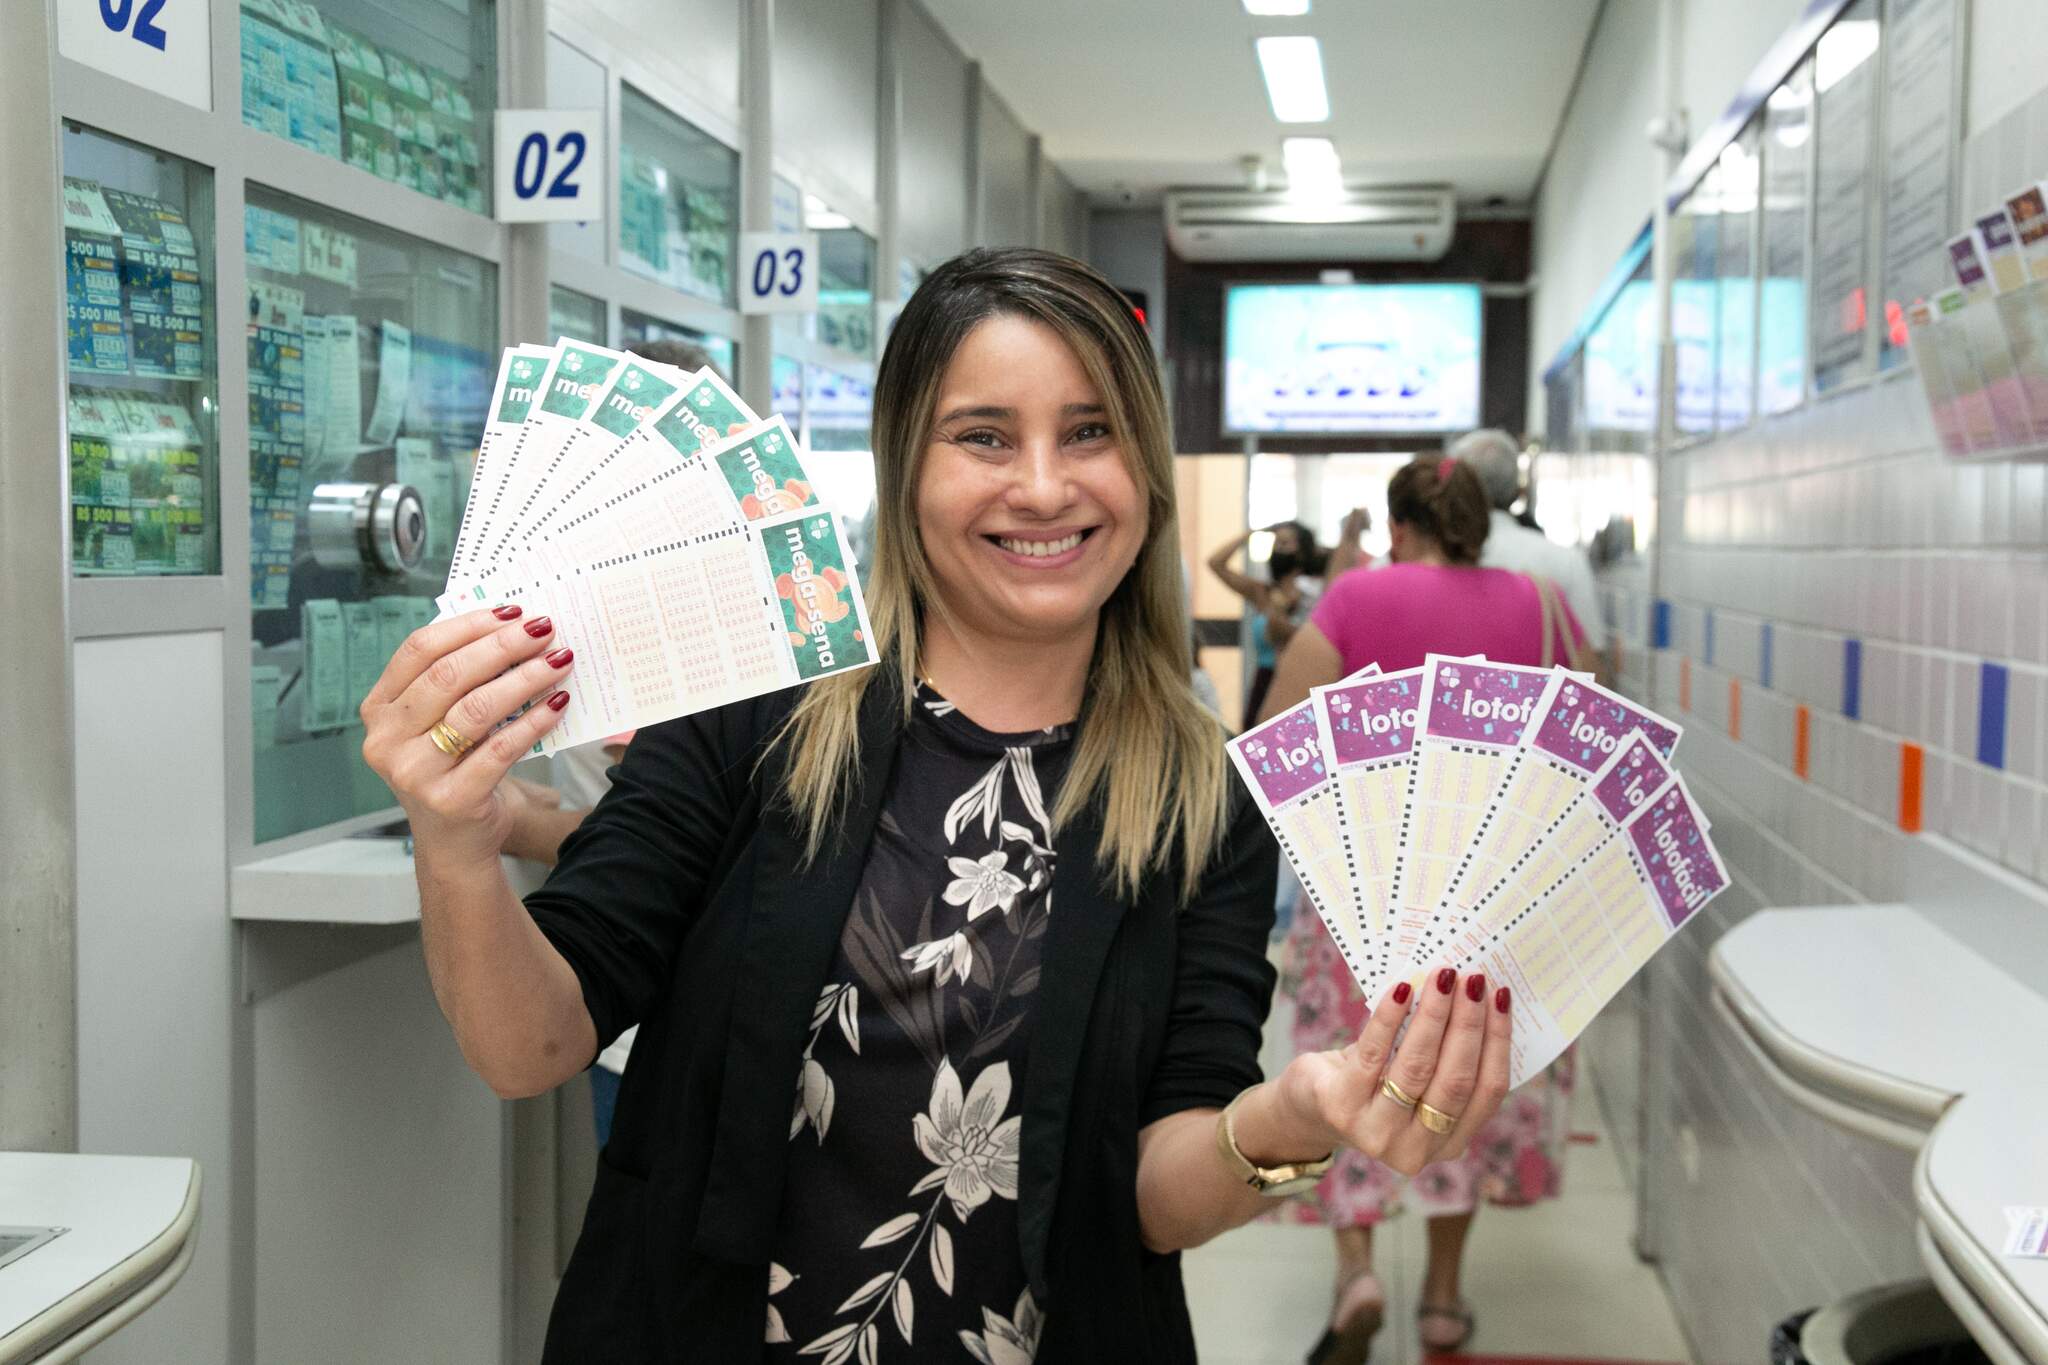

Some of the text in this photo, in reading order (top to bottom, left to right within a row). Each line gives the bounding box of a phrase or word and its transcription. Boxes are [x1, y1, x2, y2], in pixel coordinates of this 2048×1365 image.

[513, 131, 587, 199] 02
[752, 247, 805, 297] 03
[785, 527, 835, 668] mega-sena
[1360, 707, 1419, 736] loto
[1654, 819, 1706, 910] lotofácil
